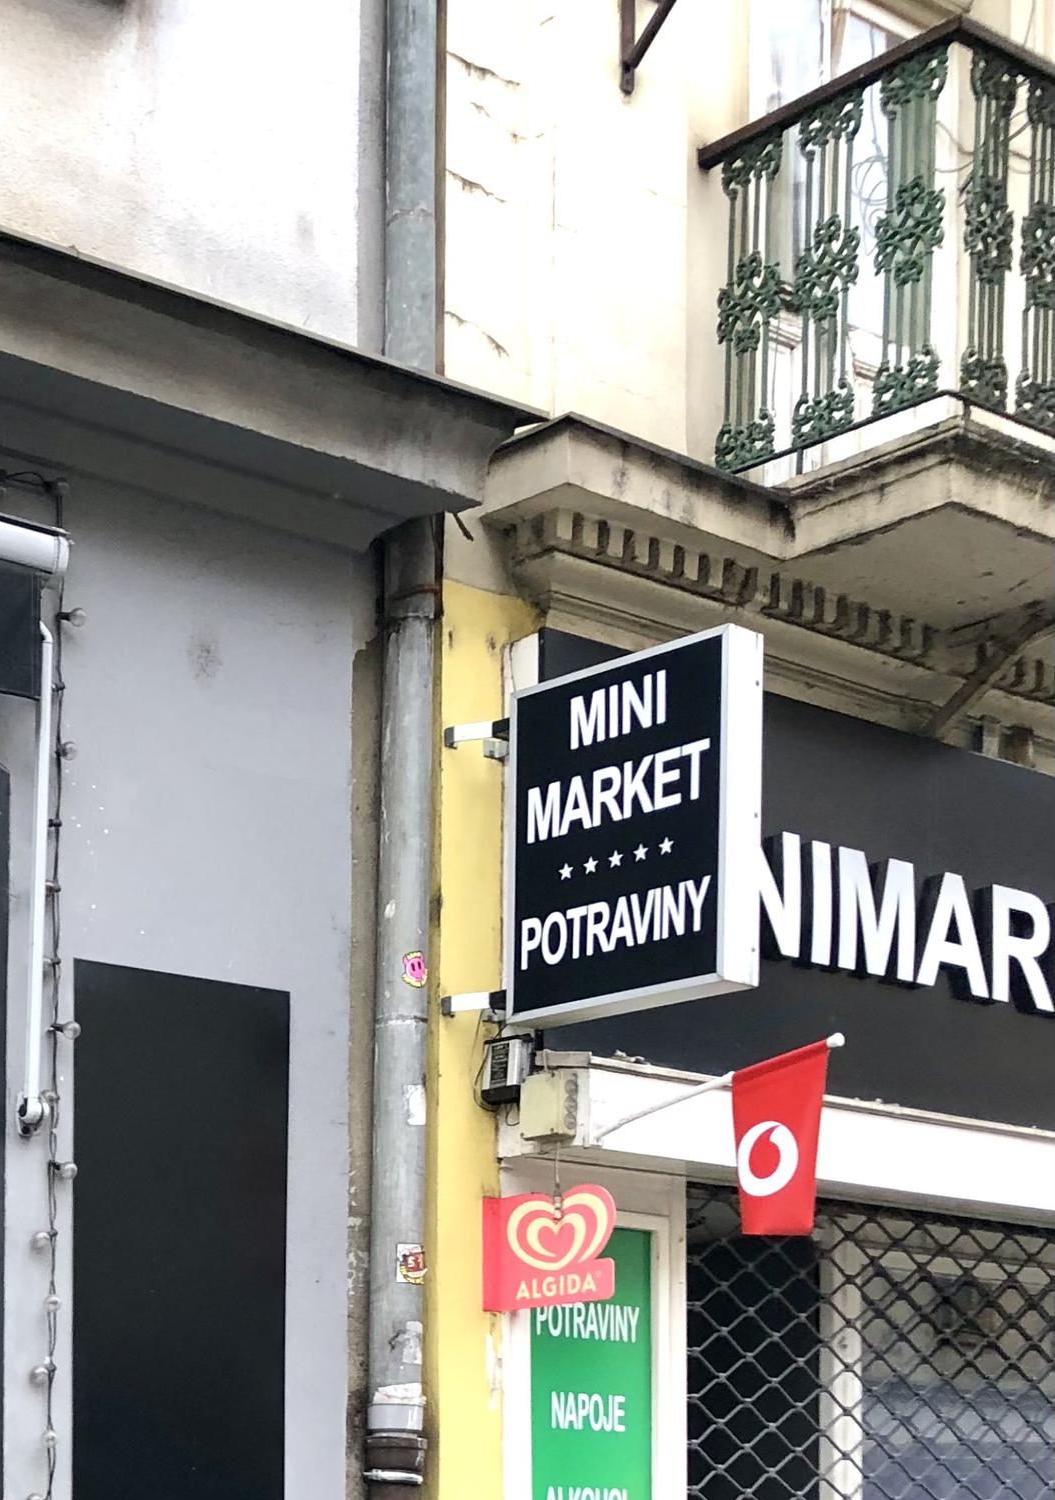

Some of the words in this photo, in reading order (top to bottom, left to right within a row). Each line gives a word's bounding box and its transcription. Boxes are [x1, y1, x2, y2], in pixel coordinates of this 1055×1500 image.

[570, 669, 667, 750] MINI
[527, 737, 711, 844] MARKET
[520, 875, 711, 971] POTRAVINY
[516, 1272, 597, 1300] ALGIDA
[536, 1302, 640, 1343] POTRAVINY
[551, 1391, 626, 1433] NAPOJE
